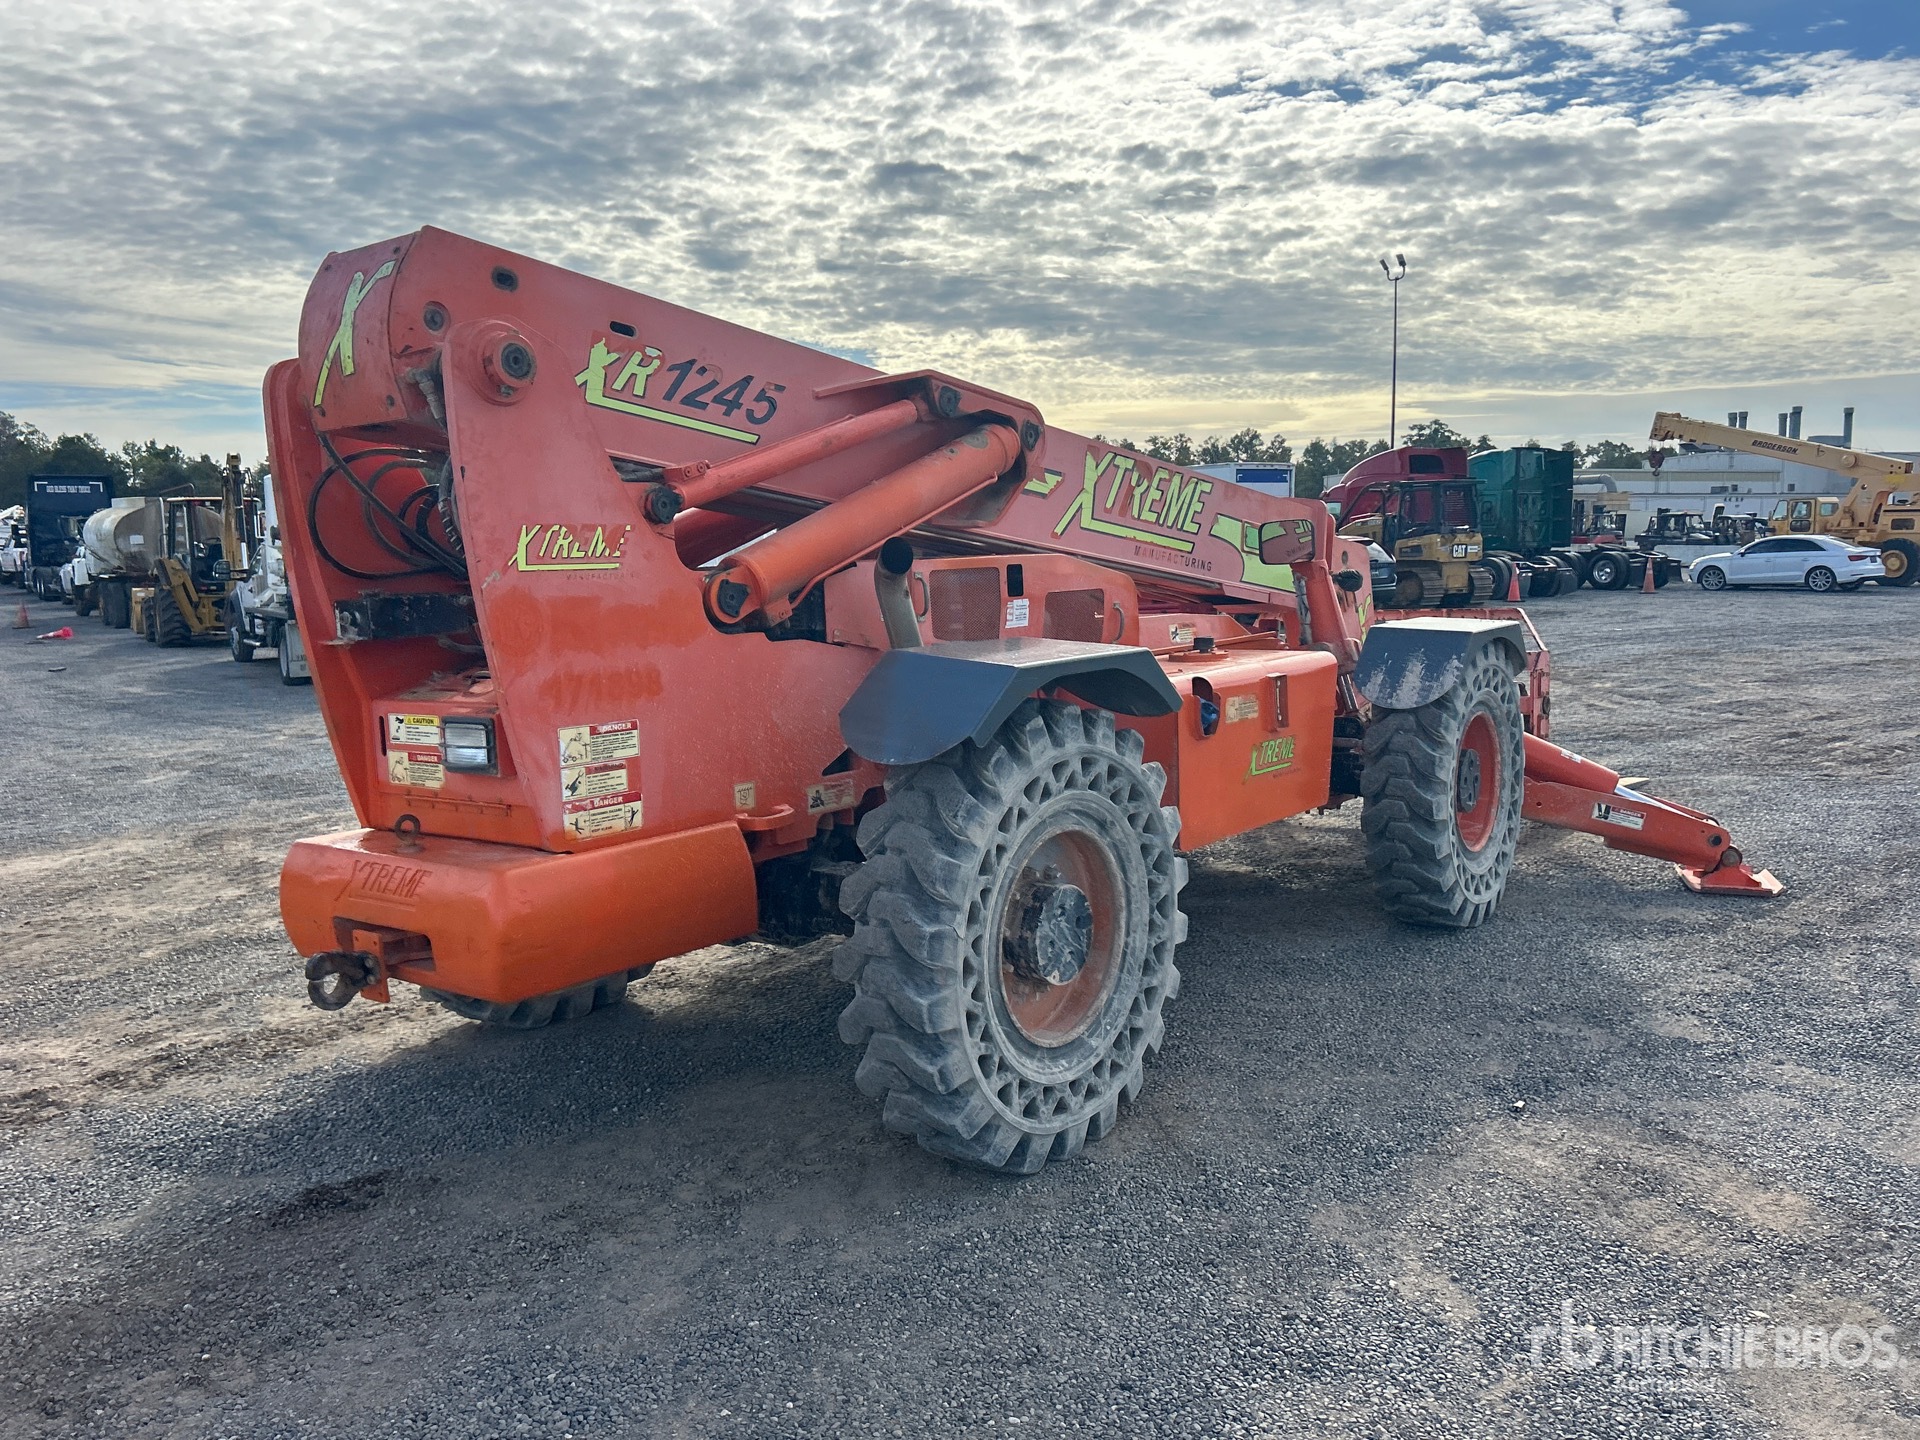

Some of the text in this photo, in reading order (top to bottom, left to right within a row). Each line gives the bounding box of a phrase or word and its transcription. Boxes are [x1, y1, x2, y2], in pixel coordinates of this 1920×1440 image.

[1752, 439, 1799, 455] BRODERSON
[1053, 449, 1214, 538] XTREME
[1134, 544, 1212, 572] MANUFACTURING
[1452, 544, 1467, 558] CAT
[412, 717, 435, 725] CAUTION
[602, 722, 632, 733] DANGER
[1242, 735, 1295, 785] XTREME
[593, 796, 624, 807] DANGER
[334, 860, 433, 902] XTREME
